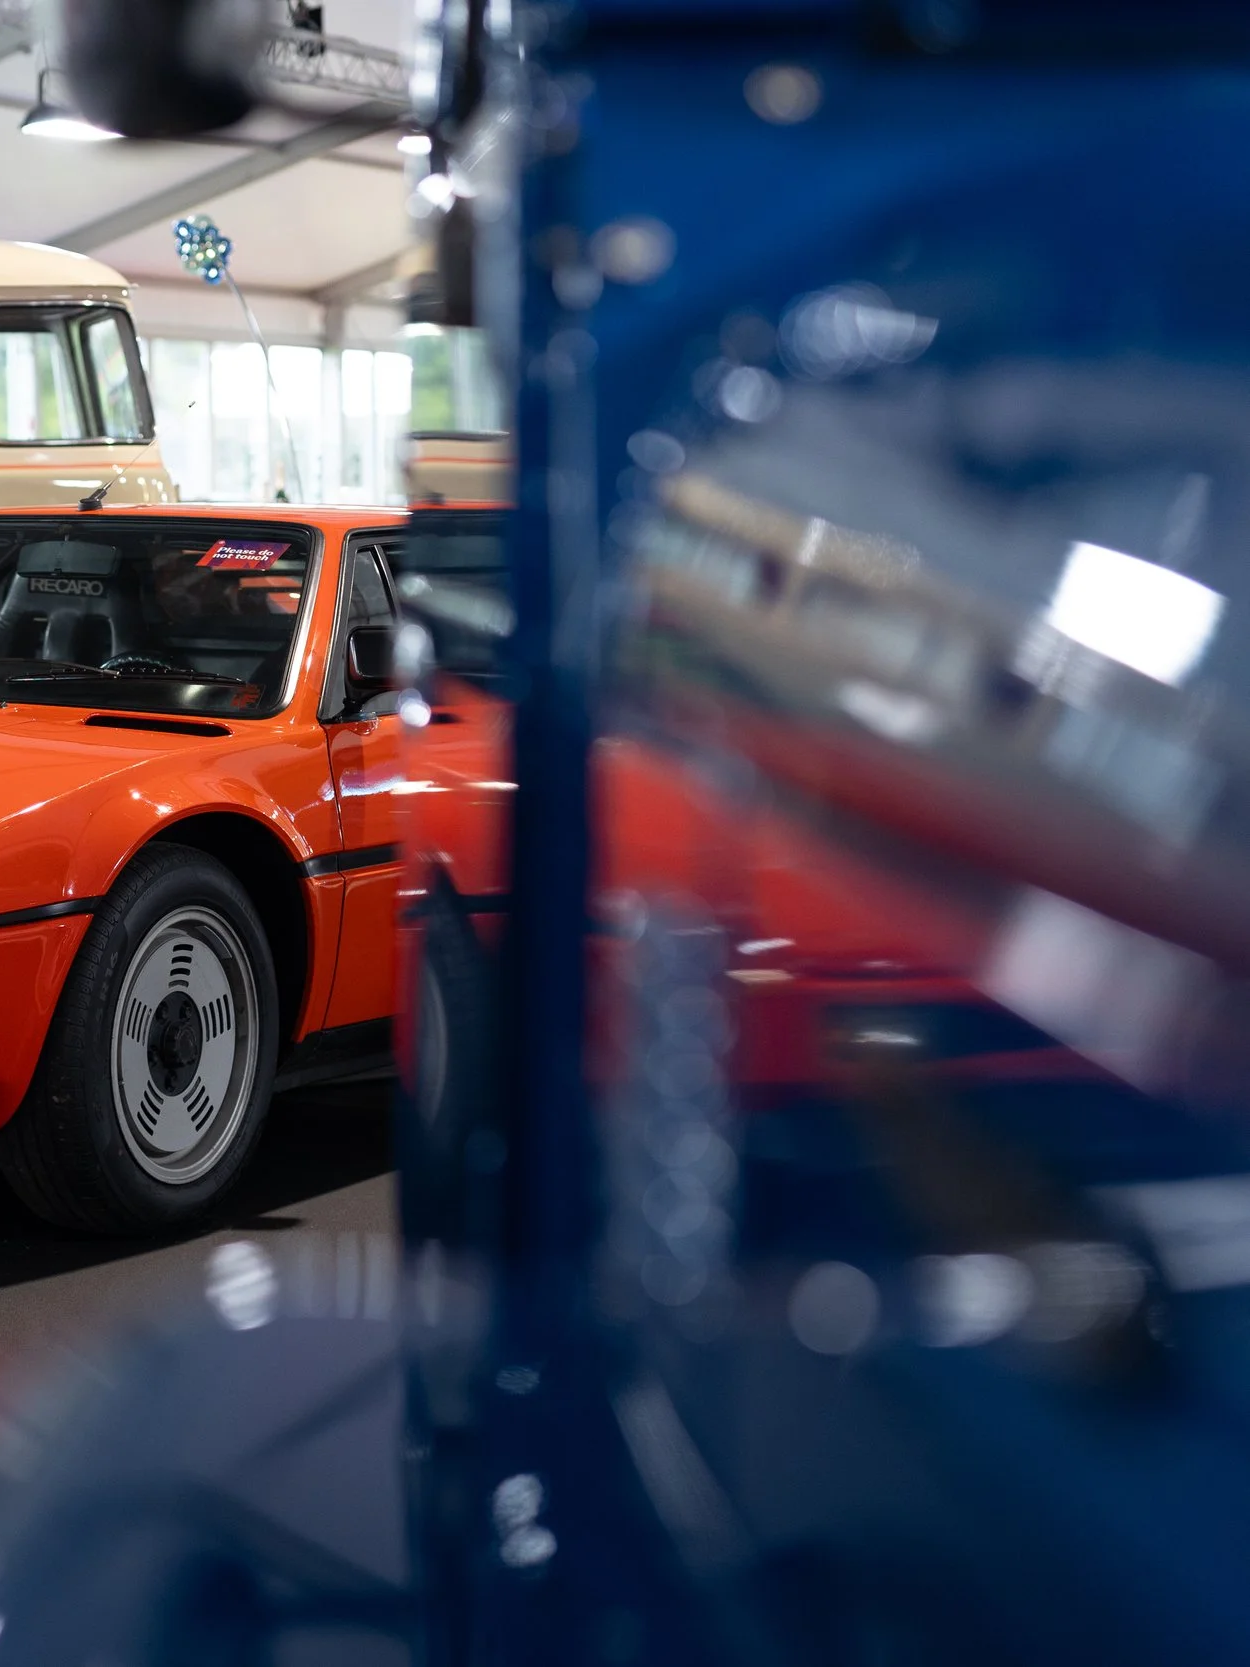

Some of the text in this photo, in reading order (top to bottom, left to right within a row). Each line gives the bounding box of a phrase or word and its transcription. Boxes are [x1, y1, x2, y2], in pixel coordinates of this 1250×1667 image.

[216, 546, 256, 555] Please
[235, 553, 269, 561] touch
[30, 578, 104, 596] RECARO
